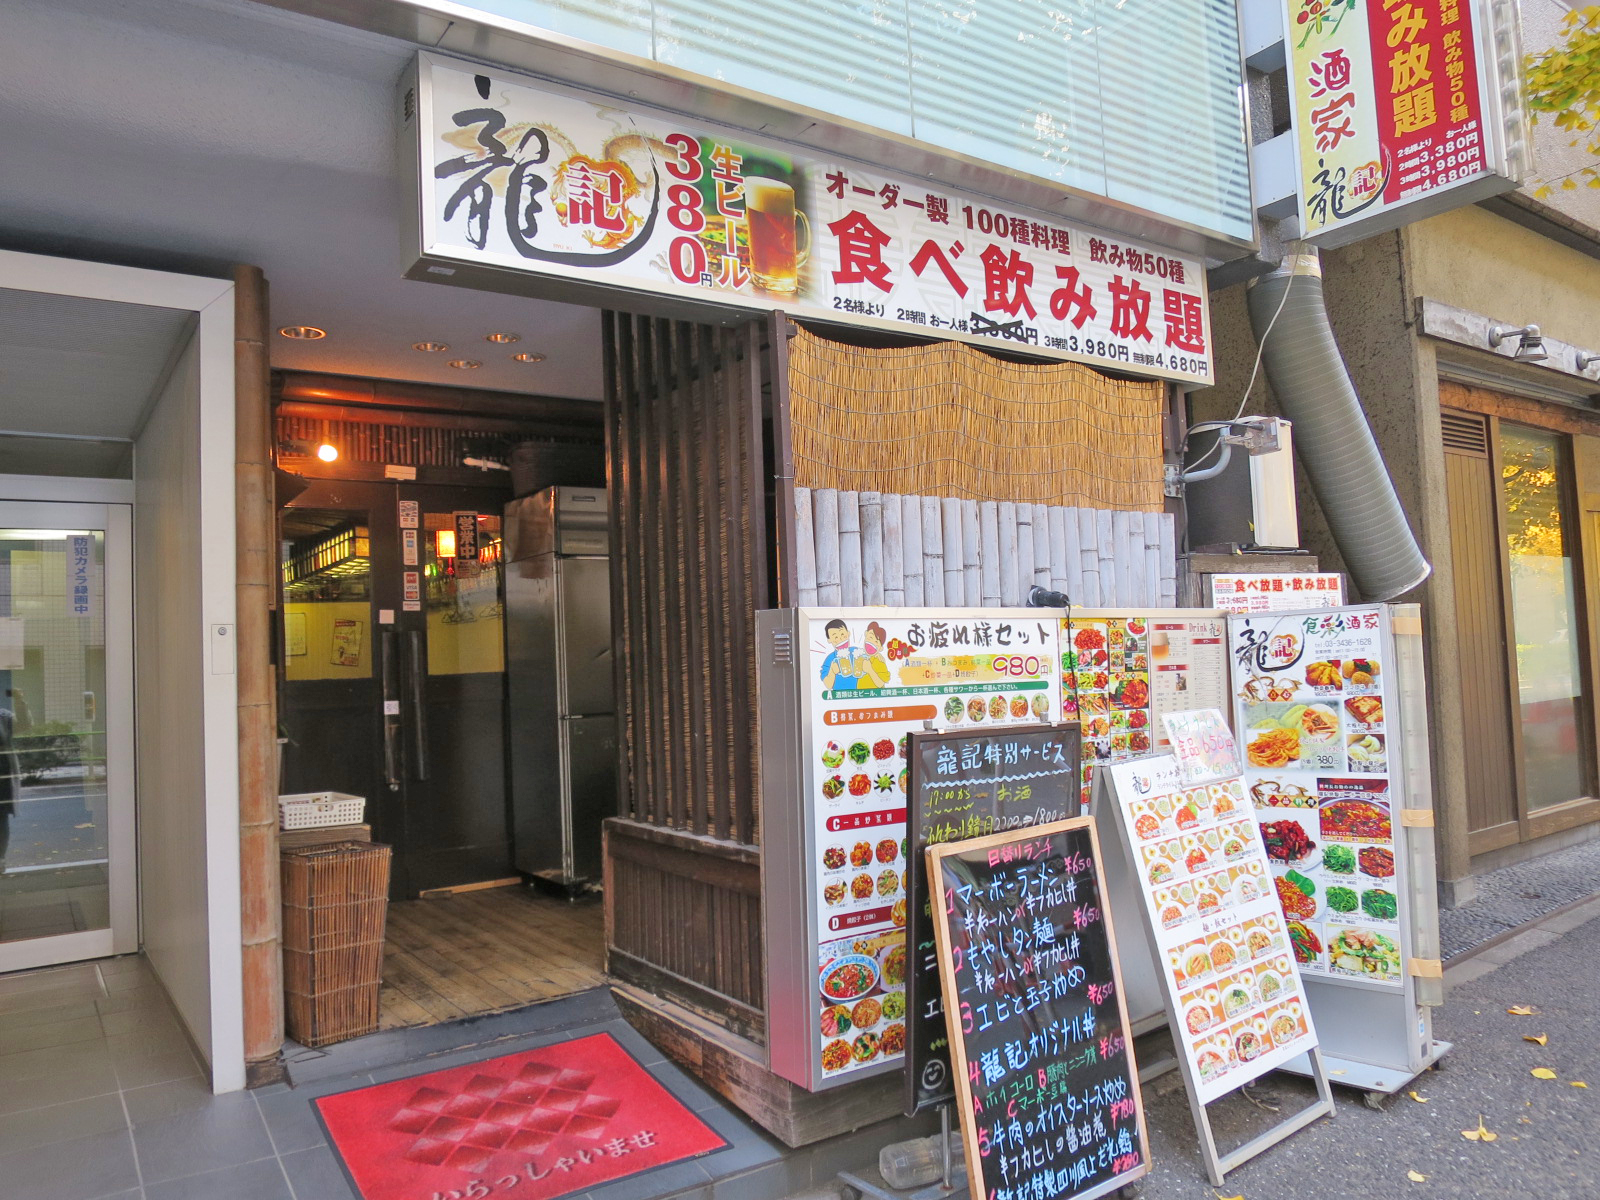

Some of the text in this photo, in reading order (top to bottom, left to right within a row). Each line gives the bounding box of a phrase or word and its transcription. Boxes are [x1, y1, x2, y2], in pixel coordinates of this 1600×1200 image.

[1382, 0, 1438, 138] み放題
[1308, 48, 1356, 154] 酒家
[709, 143, 751, 290] 生ビール
[825, 170, 1185, 285] オーダー製 100種料理 飲み物50種
[827, 209, 1206, 356] 食べ飲み放題
[832, 296, 885, 318] 2名様より
[896, 307, 927, 326] 2時間
[458, 515, 477, 560] 営業中
[73, 537, 89, 615] 防犯カメラ録画中
[907, 621, 1050, 648] お疲れ様セット
[1188, 622, 1208, 633] Drink
[992, 655, 1049, 678] 980円
[996, 782, 1032, 802] お酒
[987, 838, 1053, 869] 日替りランチ
[1063, 851, 1093, 875] ¥650
[956, 862, 1059, 905] マーボーラーメン
[1072, 902, 1101, 931] ¥650
[966, 916, 1057, 971] もやしタン麺
[959, 964, 1087, 1035] 3 エビと玉子炒め
[1087, 982, 1114, 1006] ¥650
[1099, 1034, 1126, 1061] ¥650
[969, 1060, 982, 1087] 4
[972, 1095, 984, 1115] A
[1036, 1068, 1048, 1089] B
[977, 1127, 992, 1158] 5
[431, 1129, 657, 1200] いらっしゃいませ
